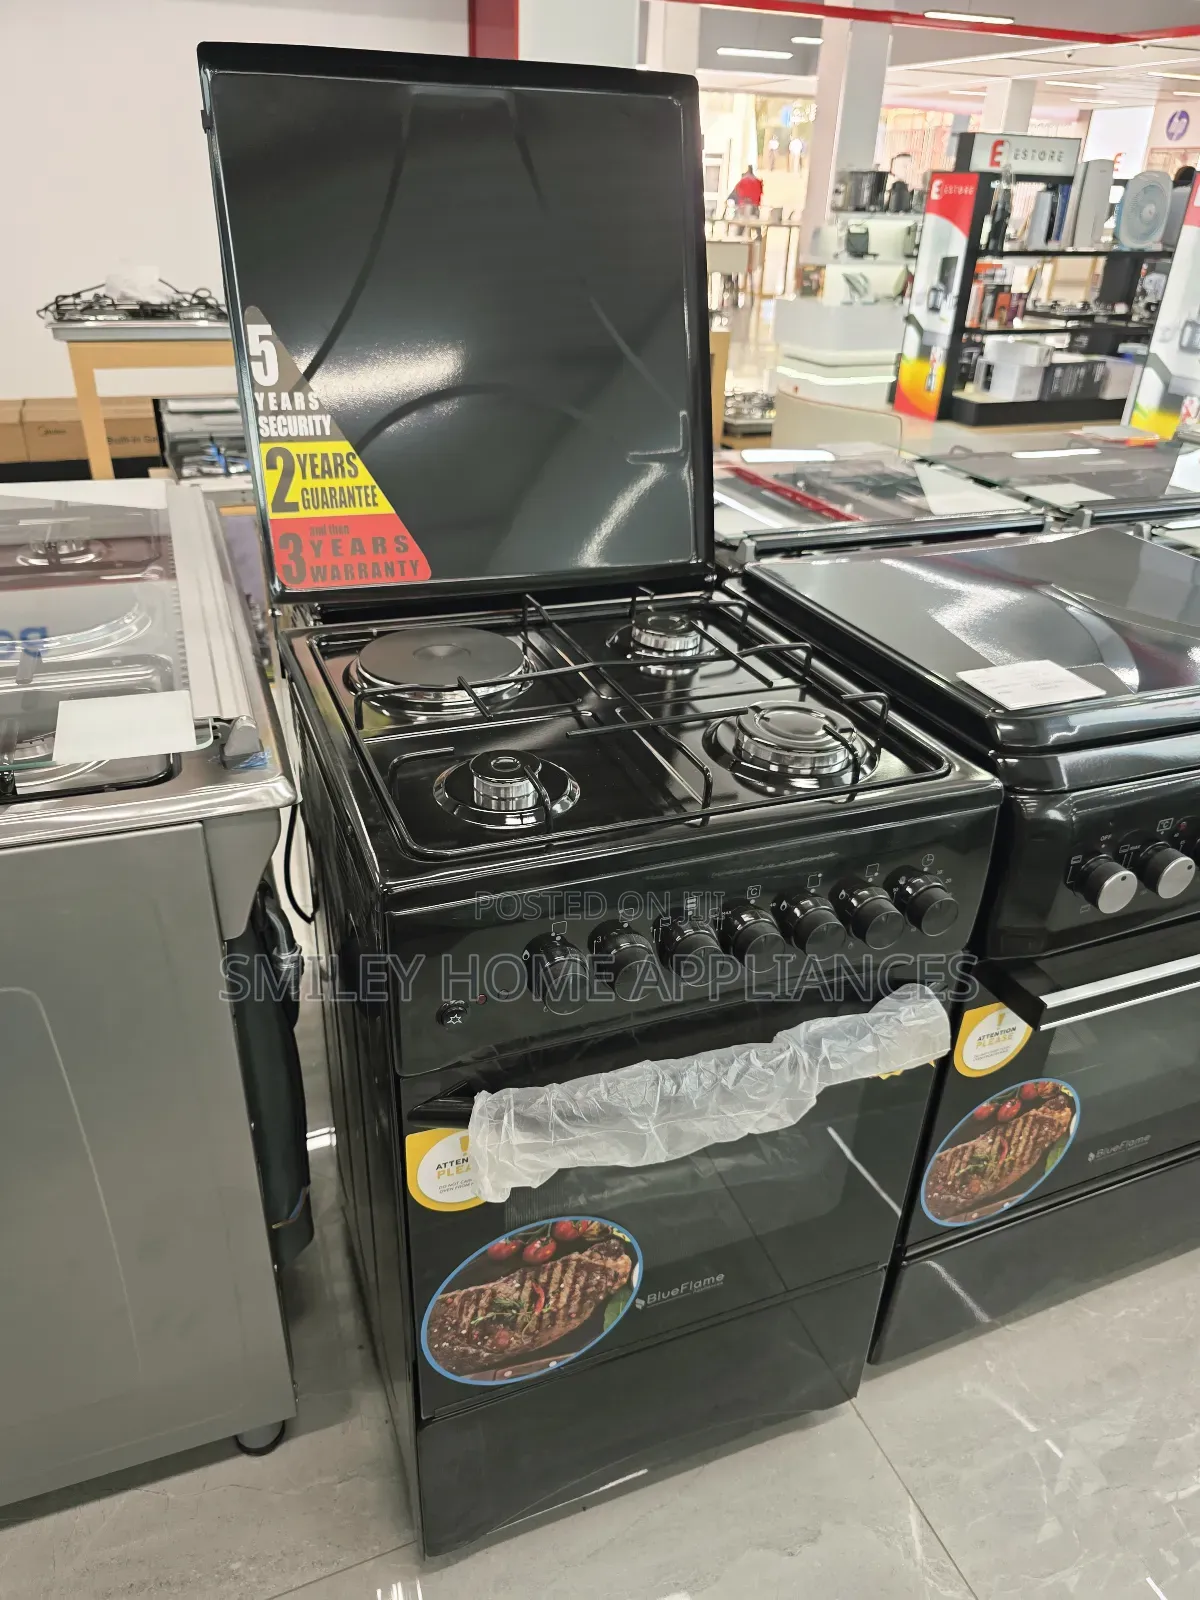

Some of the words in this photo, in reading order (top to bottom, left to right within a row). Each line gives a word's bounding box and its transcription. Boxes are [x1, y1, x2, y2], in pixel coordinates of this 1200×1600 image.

[1013, 148, 1065, 163] ESTORE
[246, 324, 279, 387] 5
[254, 391, 320, 411] YEARS
[259, 414, 332, 437] SECURITY
[265, 446, 300, 513] 2
[296, 451, 359, 480] YEARS
[300, 485, 379, 510] GUARANTEE
[309, 524, 327, 536] and
[328, 523, 349, 535] then
[278, 532, 306, 585] 3
[309, 535, 410, 558] YEARS
[310, 560, 420, 584] WARRANTY
[976, 1032, 1014, 1049] PLEASE
[977, 1026, 1017, 1041] ATTENTION
[435, 1157, 469, 1170] ATTEN
[437, 1164, 472, 1180] PLEA
[646, 1273, 725, 1304] BlueFlame
